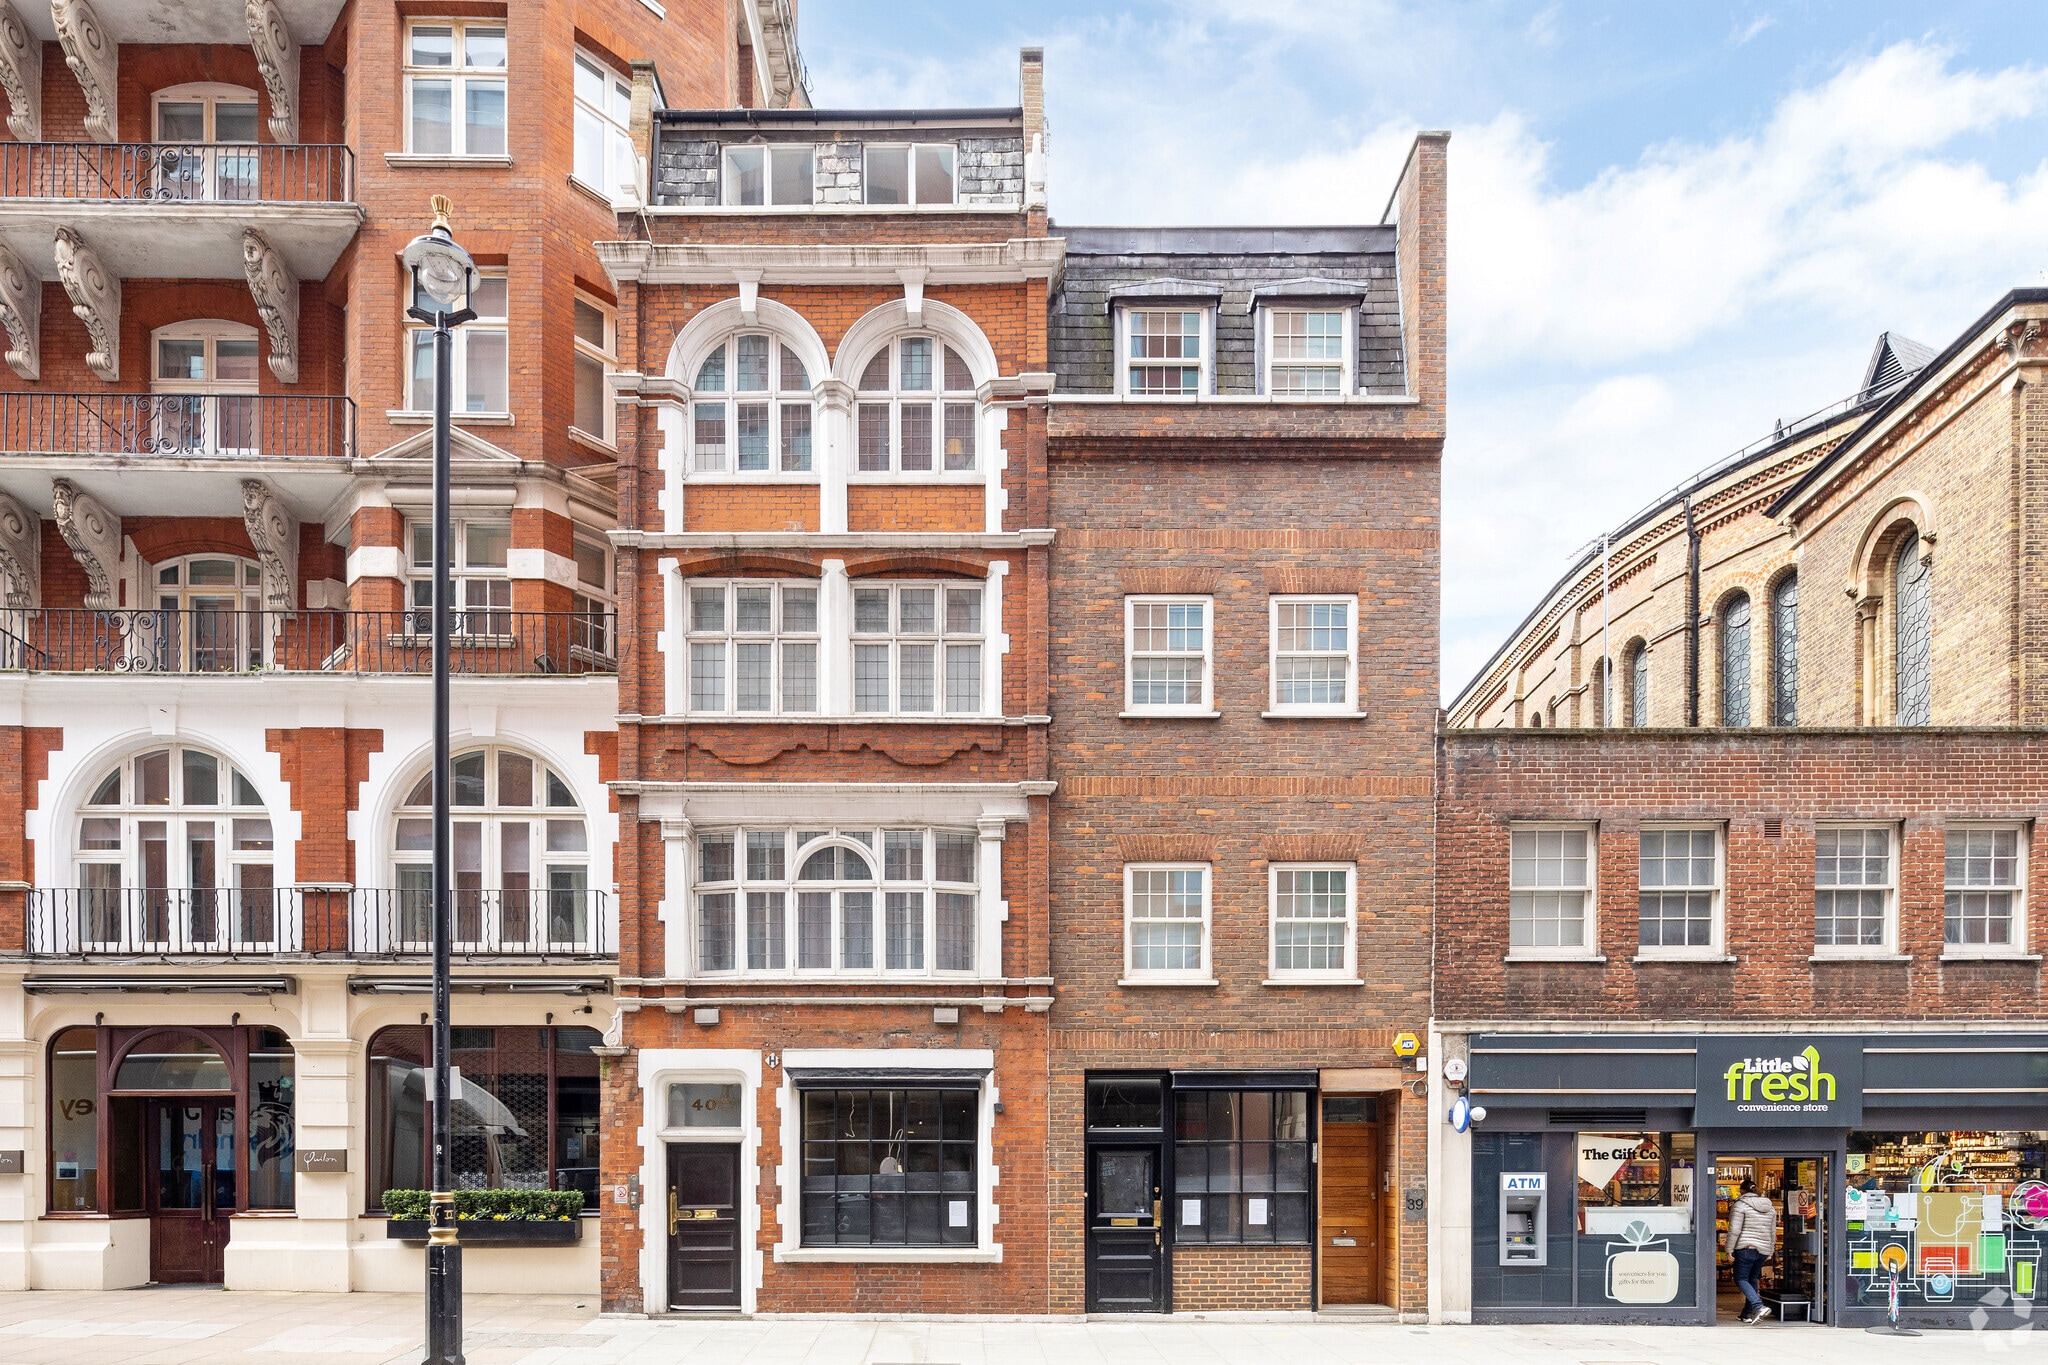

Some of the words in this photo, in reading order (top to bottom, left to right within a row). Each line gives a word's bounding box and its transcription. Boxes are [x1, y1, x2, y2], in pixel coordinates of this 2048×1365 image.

[1402, 1041, 1414, 1049] ADT
[768, 1056, 776, 1066] H
[1743, 1057, 1793, 1073] Little
[1723, 1045, 1836, 1102] fresh
[692, 1099, 718, 1111] 40
[1737, 1102, 1802, 1112] convenience
[1803, 1103, 1829, 1112] store
[1582, 1148, 1609, 1160] The
[1612, 1148, 1637, 1160] Gift
[1640, 1149, 1660, 1160] Co.
[1507, 1178, 1541, 1189] ATM
[1673, 1184, 1690, 1193] PLAY
[1673, 1194, 1690, 1202] NOW
[1407, 1198, 1424, 1211] 39
